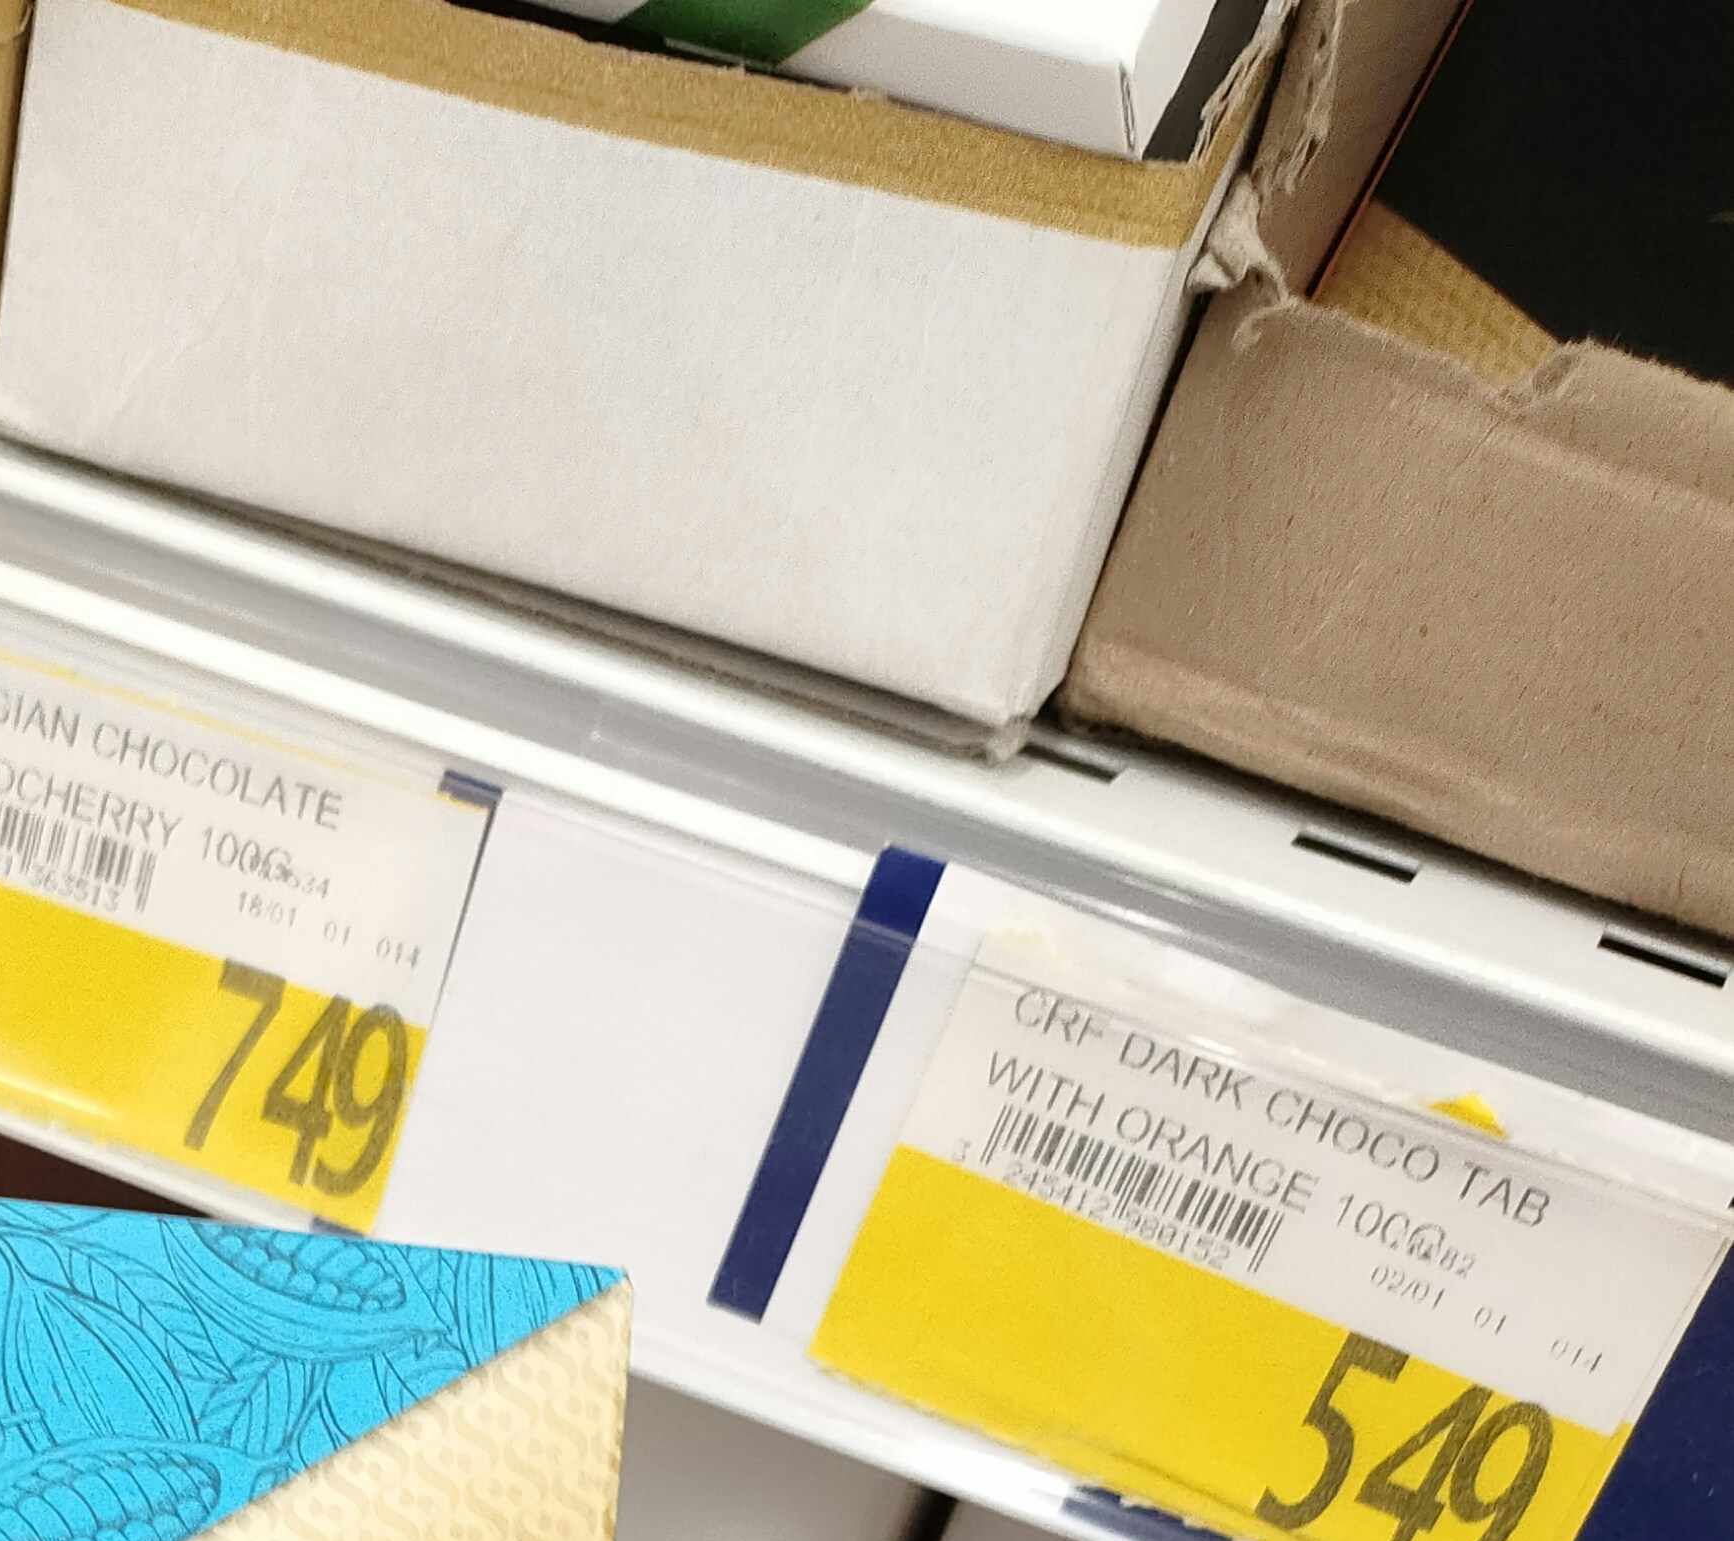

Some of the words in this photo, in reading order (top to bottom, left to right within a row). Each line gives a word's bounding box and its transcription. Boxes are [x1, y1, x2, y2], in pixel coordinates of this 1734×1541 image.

[92, 721, 343, 832] CHOCOLATE
[324, 920, 352, 946] 01
[376, 936, 421, 969] 014
[183, 958, 409, 1197] 749
[987, 1051, 1107, 1126] WITH
[1116, 1106, 1320, 1214] ORANGE
[1016, 989, 1104, 1046] CRF
[1119, 1032, 1255, 1109] DARK
[1265, 1088, 1440, 1182] CHOCO
[1459, 1160, 1551, 1227] TAB
[1370, 1265, 1445, 1309] 02/01
[1473, 1306, 1507, 1334] 01
[1551, 1338, 1602, 1374] 014
